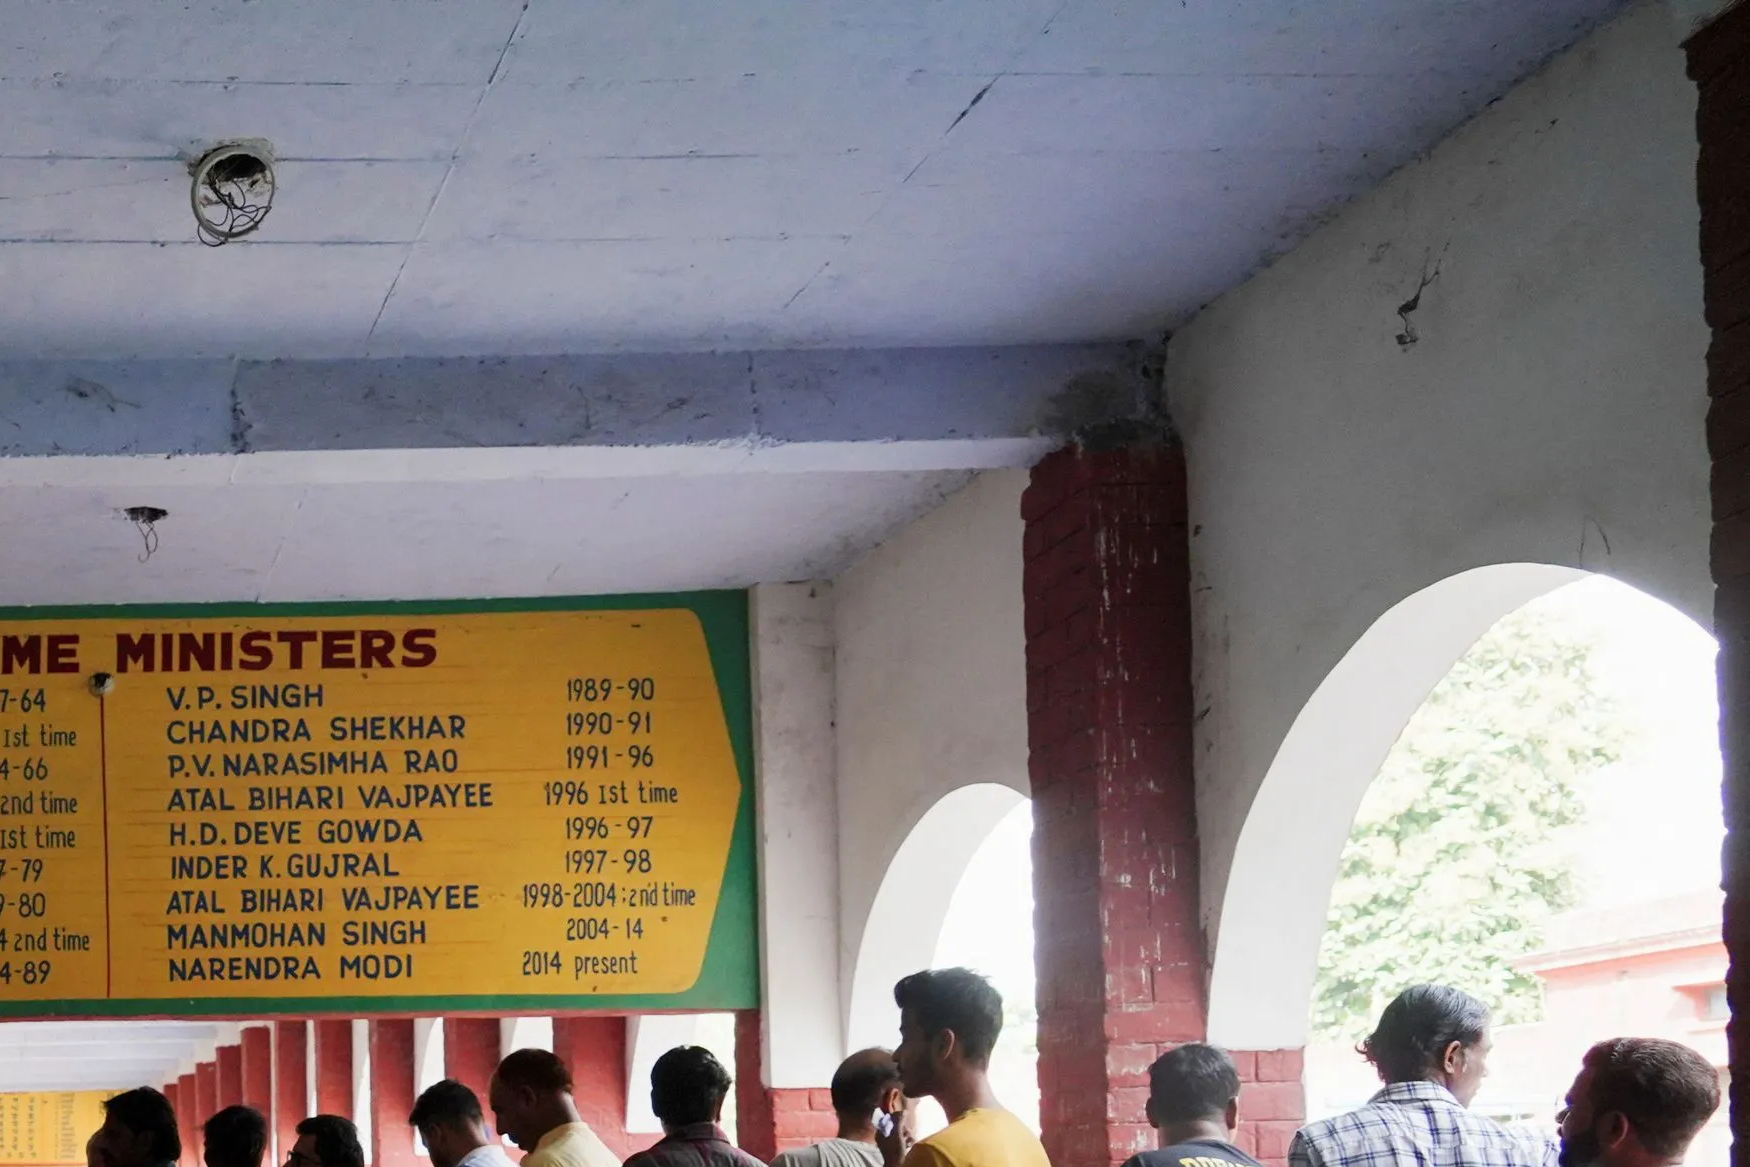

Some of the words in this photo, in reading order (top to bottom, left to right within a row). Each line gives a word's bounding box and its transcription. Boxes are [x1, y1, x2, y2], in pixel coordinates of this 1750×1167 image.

[116, 627, 437, 673] MINISTERS
[230, 684, 323, 709] SINGH
[40, 724, 77, 747] time
[167, 718, 311, 744] CHANDRA
[330, 715, 466, 742] SHEKHAR
[223, 750, 388, 777] NARASIMHA
[404, 749, 458, 774] RAO
[0, 791, 33, 815] 2nd
[40, 790, 78, 814] time
[167, 788, 235, 812] ATAL
[248, 785, 343, 811] BIHARI
[358, 783, 493, 808] VAJPAYEE
[545, 781, 588, 806] 1996
[638, 780, 678, 803] time
[35, 825, 76, 848] time
[234, 820, 301, 845] DEVE
[318, 819, 423, 843] GOWDA
[171, 855, 248, 880] INDER
[166, 890, 225, 915] ATAL
[240, 888, 323, 914] BIHARI
[341, 885, 479, 911] VAJPAYEE
[662, 882, 696, 906] time
[13, 927, 47, 952] 2nd
[53, 927, 90, 950] time
[167, 922, 325, 949] MANMOHAN
[342, 920, 426, 946] SINGH
[169, 956, 321, 982] NARENDRA
[340, 953, 412, 979] MODI
[522, 951, 562, 976] 2014
[574, 951, 638, 980] present
